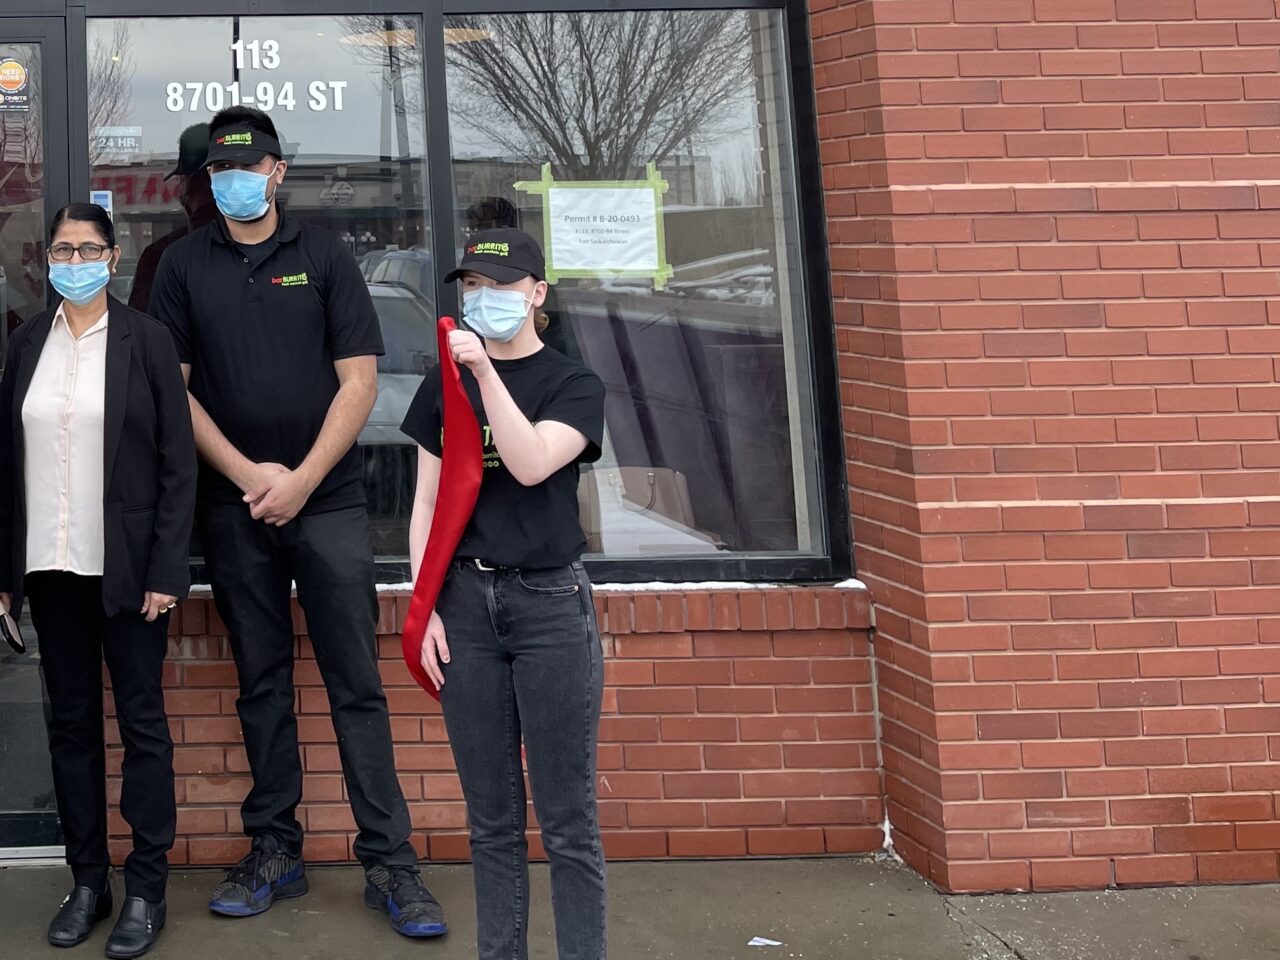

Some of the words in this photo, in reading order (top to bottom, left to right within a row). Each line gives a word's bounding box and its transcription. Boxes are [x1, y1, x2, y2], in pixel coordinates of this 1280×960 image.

[231, 39, 281, 70] 113
[166, 81, 296, 112] 8701-94
[308, 80, 348, 111] ST
[98, 138, 115, 148] 24
[118, 137, 140, 148] HR.
[564, 215, 591, 223] Permit
[599, 215, 641, 223] B-20-0493
